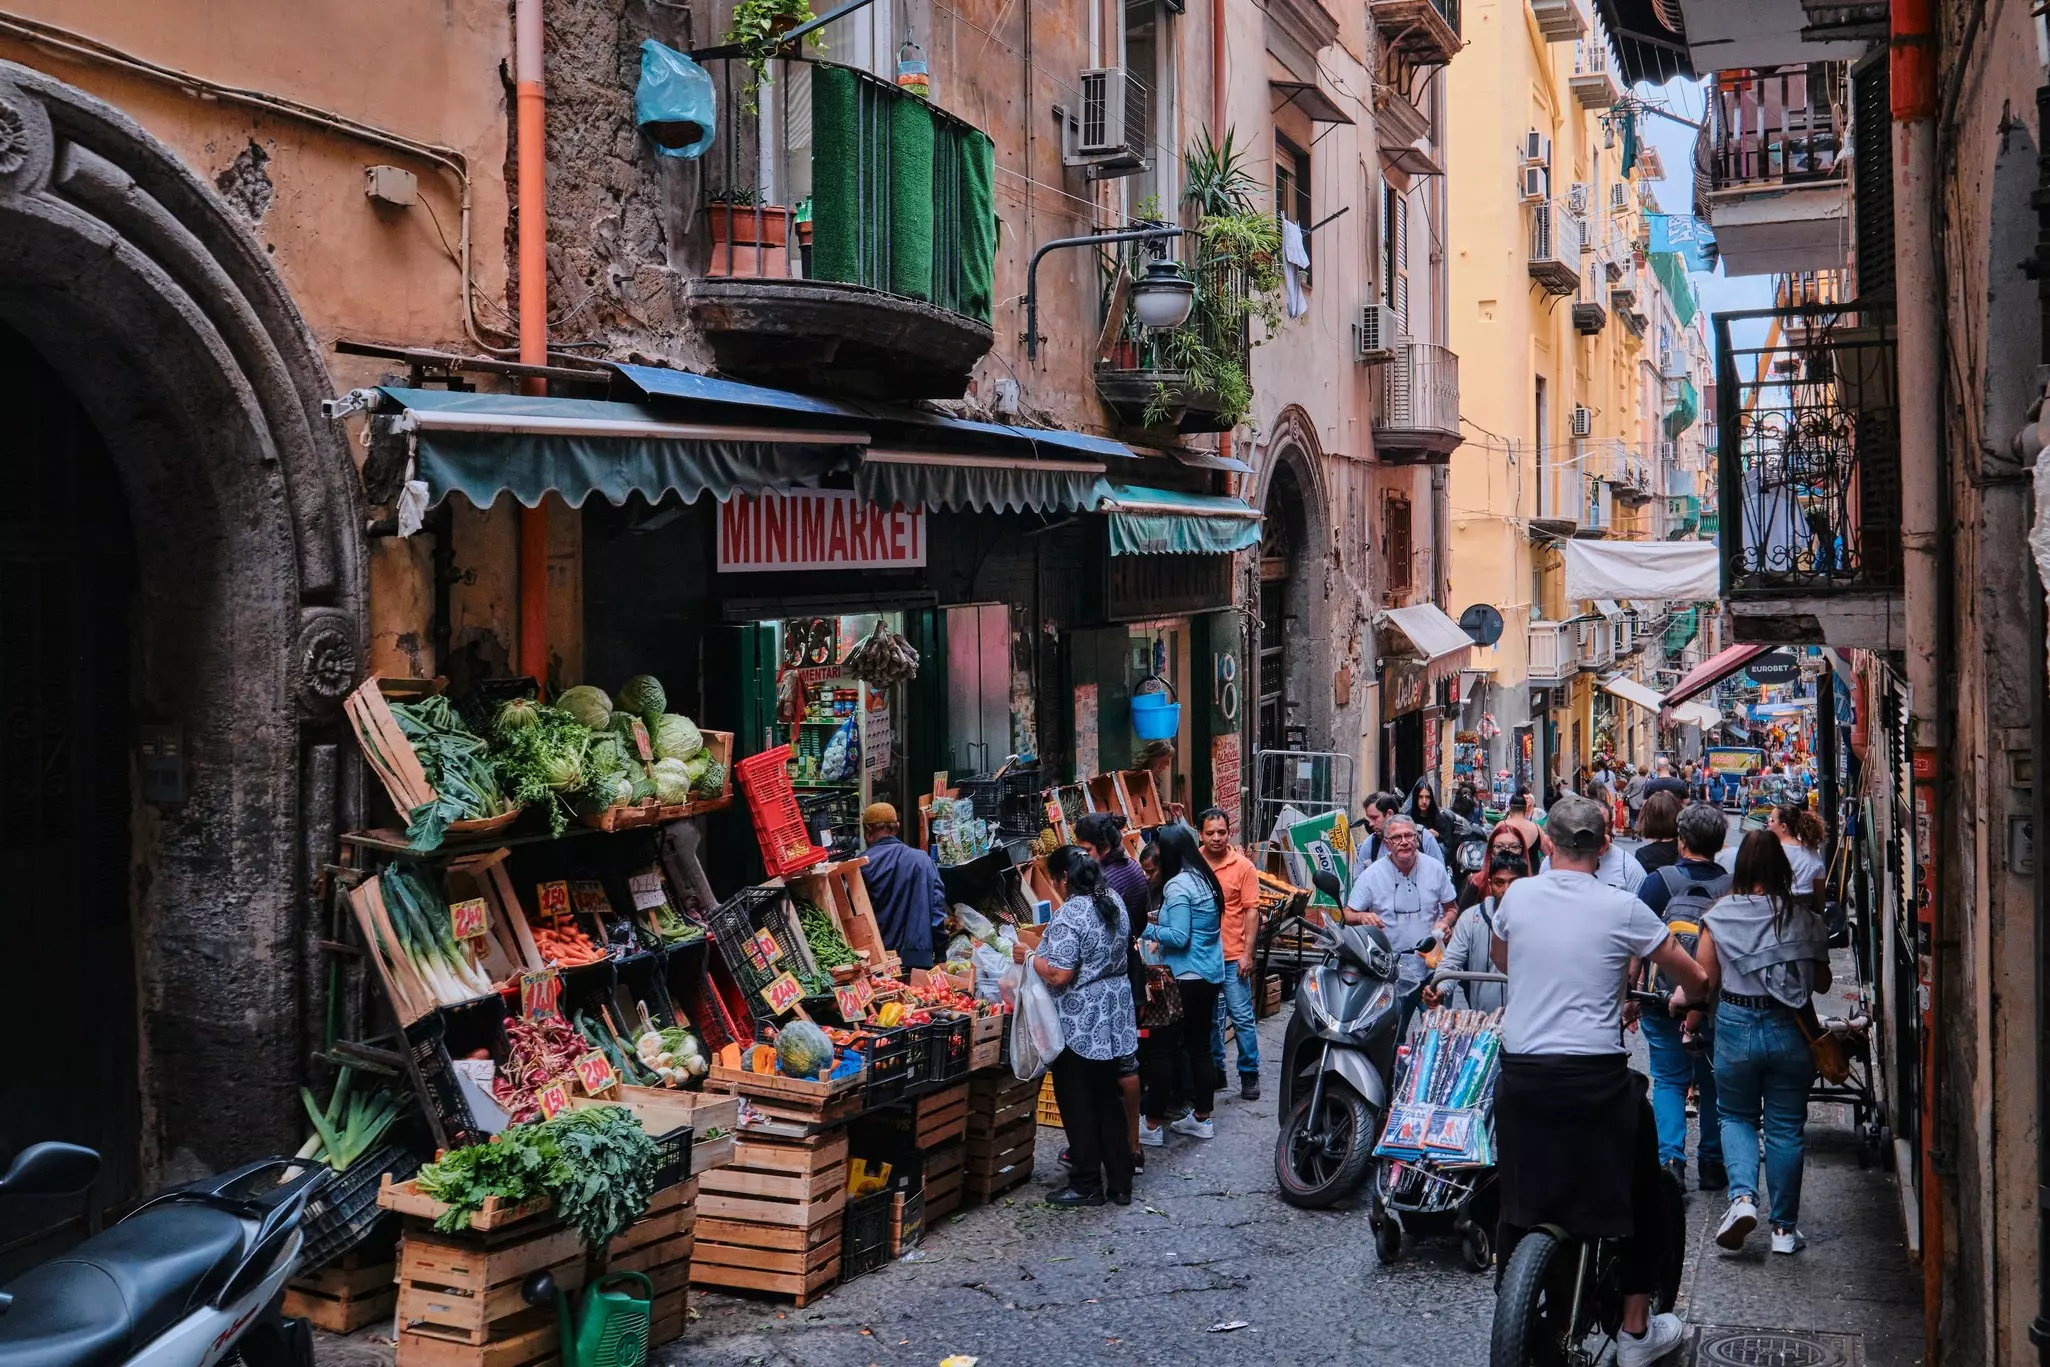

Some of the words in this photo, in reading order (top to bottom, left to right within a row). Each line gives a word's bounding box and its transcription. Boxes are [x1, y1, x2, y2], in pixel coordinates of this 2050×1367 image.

[722, 493, 922, 564] MINIMARKET
[801, 666, 841, 683] MENTARI
[1751, 664, 1789, 673] EUROBET
[1333, 823, 1347, 852] SCORTA
[1315, 845, 1331, 872] rona
